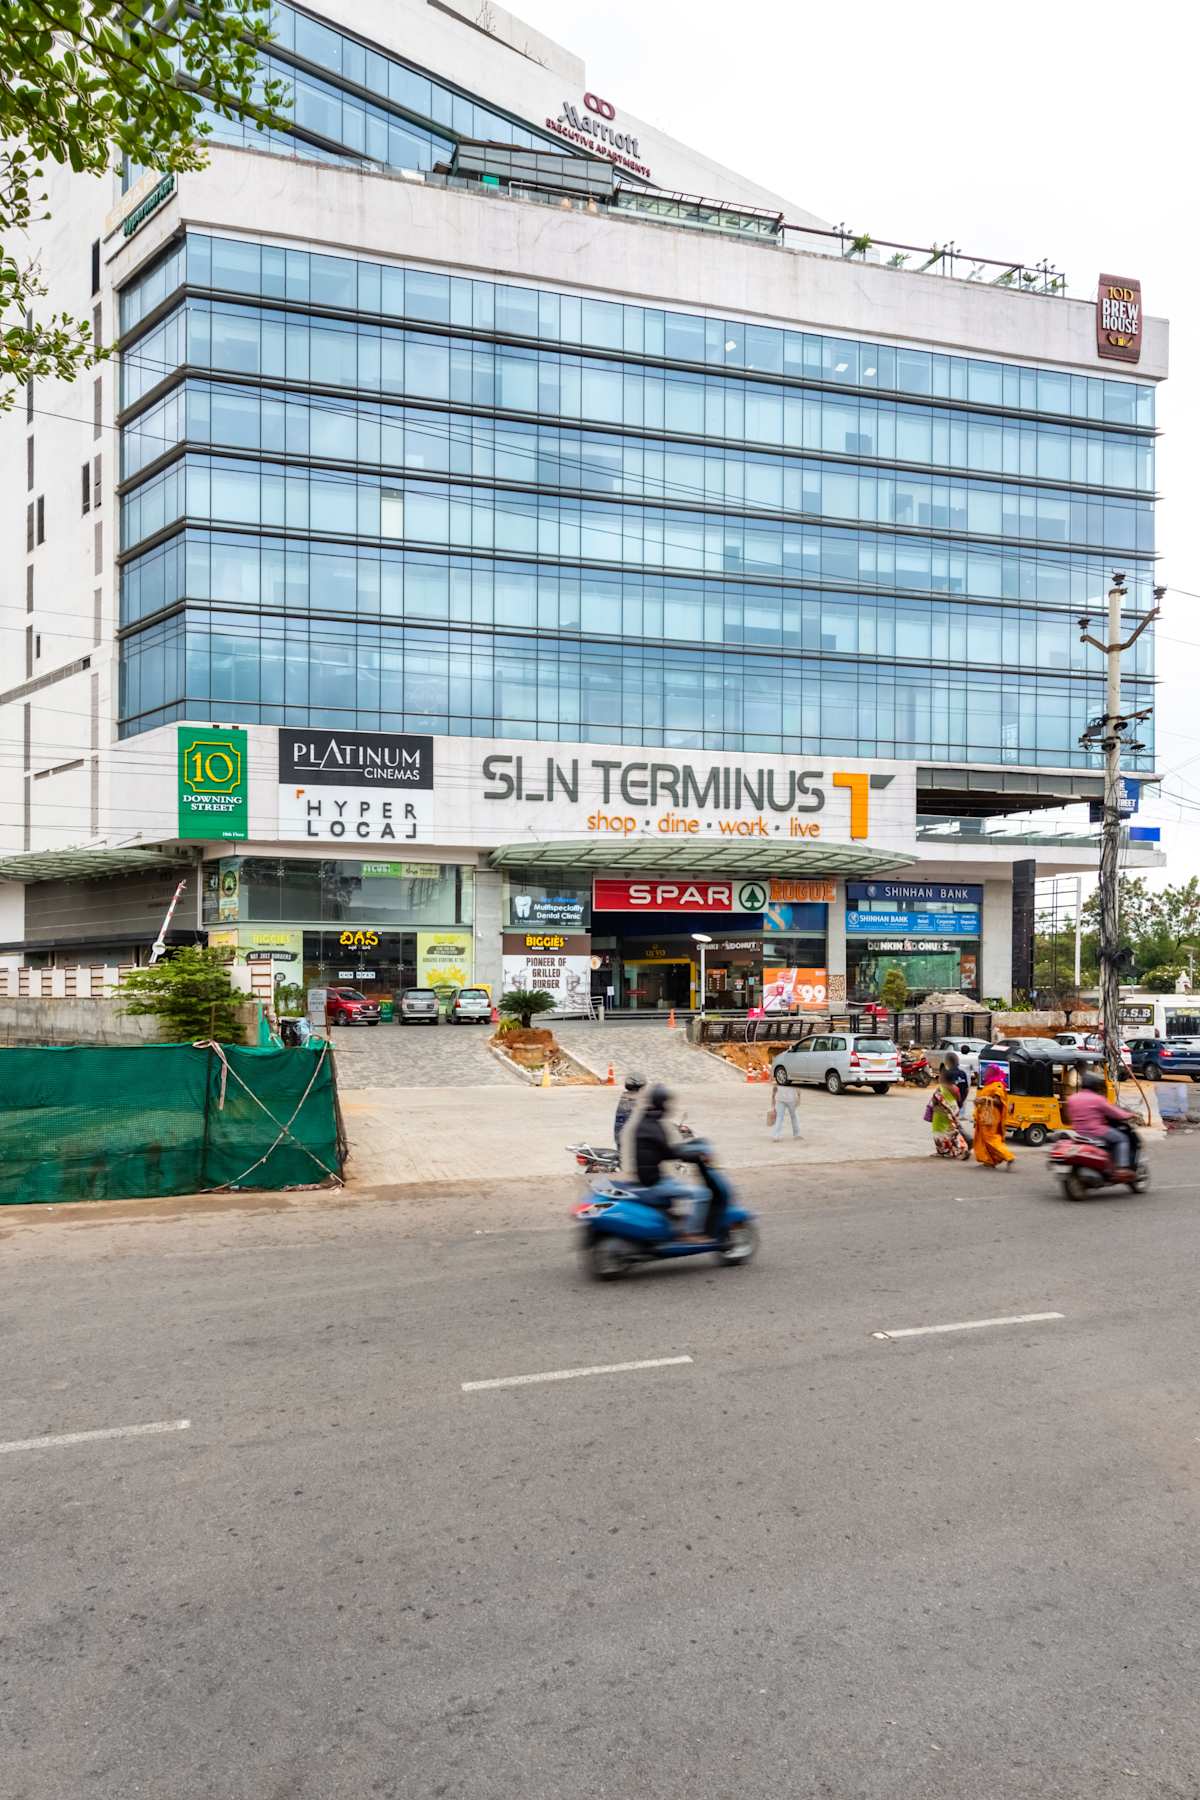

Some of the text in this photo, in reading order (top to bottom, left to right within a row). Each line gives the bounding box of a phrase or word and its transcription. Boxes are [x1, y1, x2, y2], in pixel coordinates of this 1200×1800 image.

[557, 101, 640, 159] Marriott
[545, 118, 651, 177] EXECUTIVE APARTMENTS
[1102, 298, 1139, 320] BREW
[1102, 314, 1139, 334] HOUSE
[293, 738, 420, 769] PLATINUM
[192, 752, 234, 783] 10
[364, 768, 420, 780] CINEMAS
[482, 755, 579, 803] SLN
[591, 760, 826, 813] TERMINUS
[183, 795, 242, 804] DOWNING
[191, 803, 235, 811] STREET
[307, 800, 417, 820] HYPER
[587, 809, 822, 838] shop dine work live
[629, 884, 730, 905] SPAR
[884, 886, 968, 899] SHINHAN BANK
[859, 915, 889, 923] SHINHAN
[526, 935, 565, 947] BIGGIES
[526, 957, 567, 966] PIONEER OF
[532, 968, 560, 977] GRILLED
[532, 980, 560, 988] BURGER
